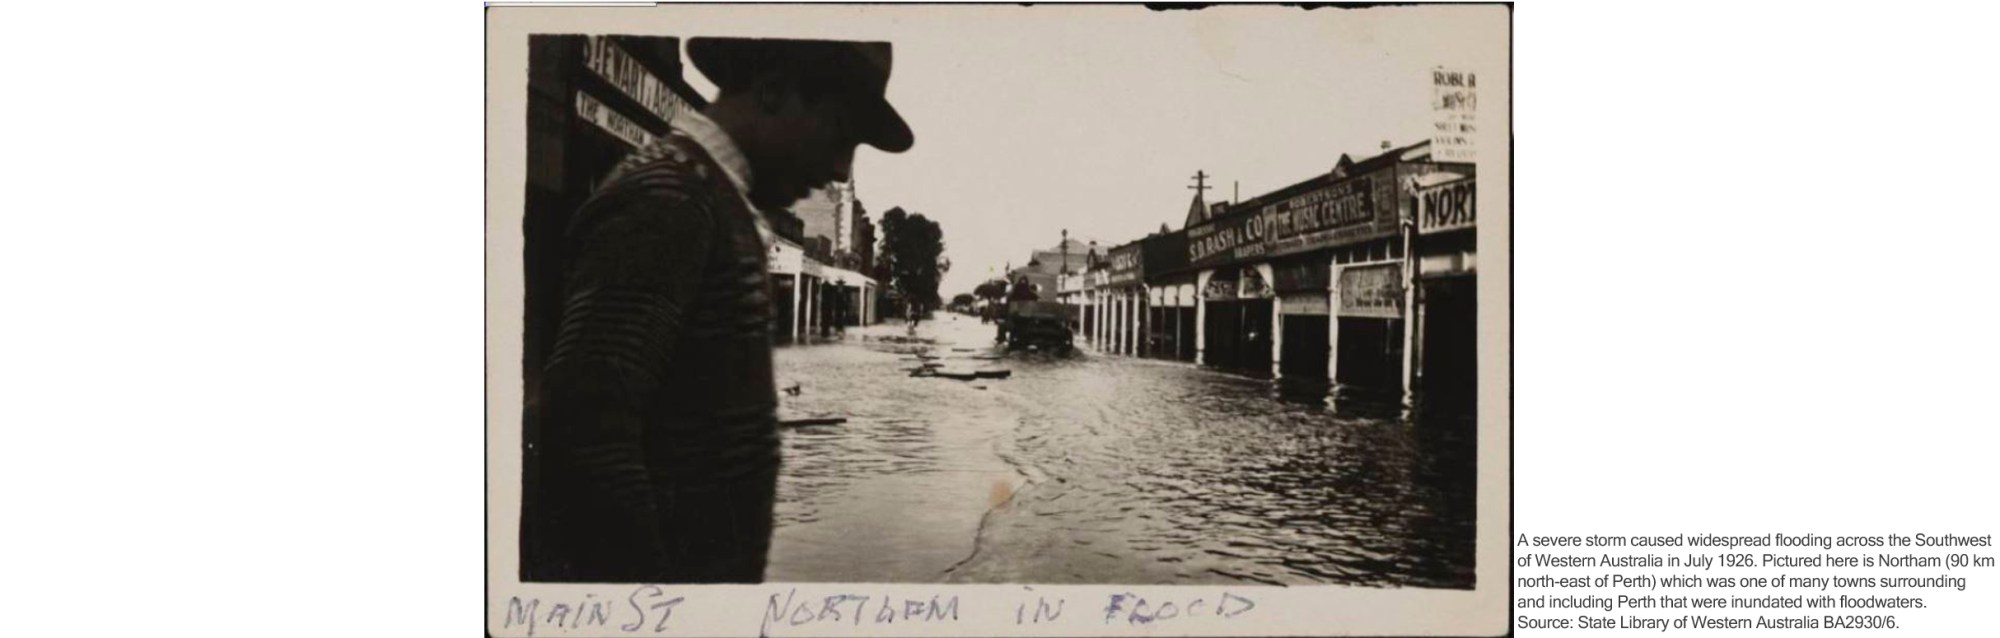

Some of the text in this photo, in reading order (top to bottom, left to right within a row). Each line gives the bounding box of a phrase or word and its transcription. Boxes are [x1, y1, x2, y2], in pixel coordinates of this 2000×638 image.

[1278, 210, 1291, 237] THE
[1292, 203, 1320, 233] MUSIC
[621, 584, 685, 633] ST
